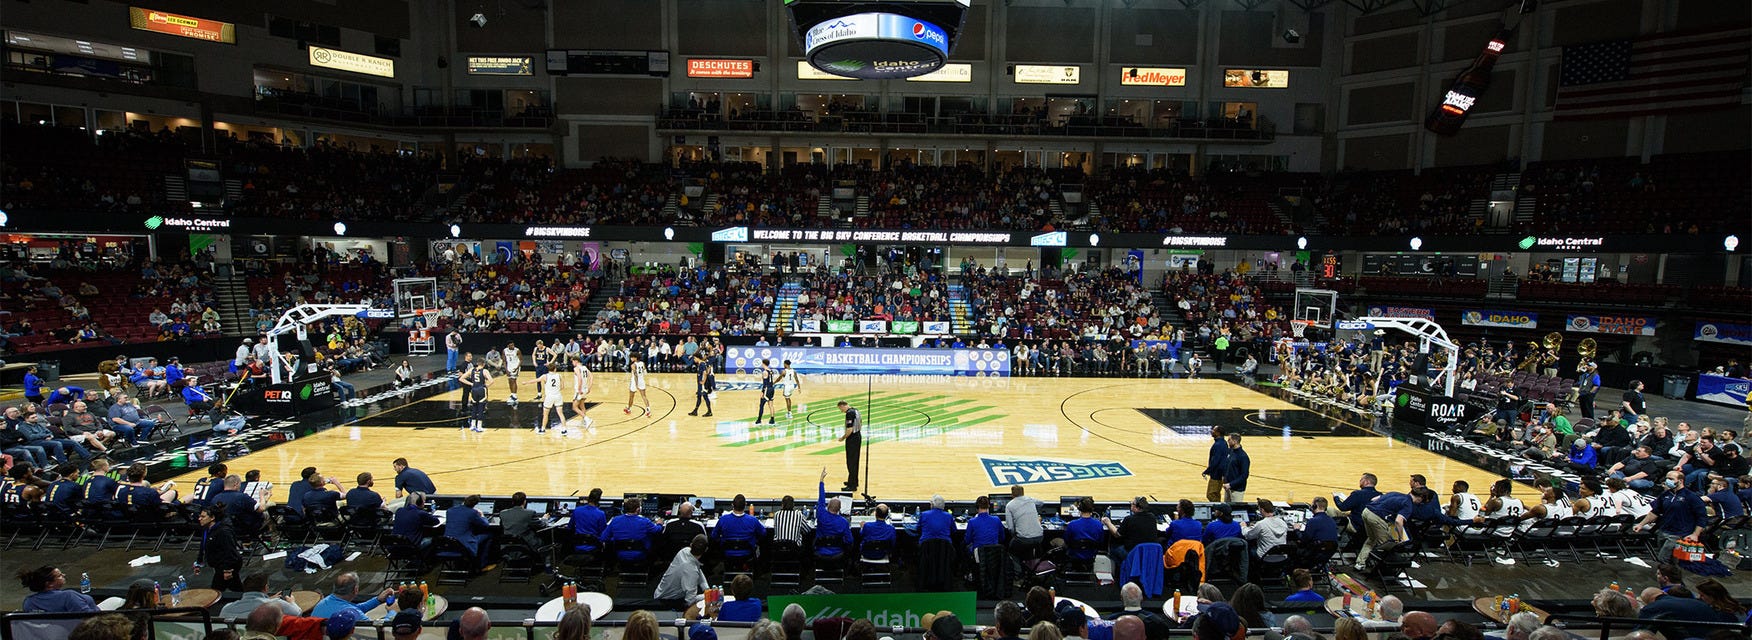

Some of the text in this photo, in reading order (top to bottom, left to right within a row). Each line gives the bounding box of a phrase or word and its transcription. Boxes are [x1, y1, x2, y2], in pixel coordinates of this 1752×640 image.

[185, 31, 215, 40] PROMISE
[812, 26, 824, 36] Blue
[812, 28, 856, 45] Cross of Idaho
[926, 29, 944, 45] pepsi
[333, 53, 359, 62] DOUBLE
[368, 59, 391, 68] RANCH
[692, 61, 749, 70] DESCHUTES
[875, 61, 938, 71] Central
[1445, 90, 1475, 106] SAMUEL
[1443, 97, 1470, 111] ADAMS
[165, 217, 230, 227] Idaho Central
[753, 230, 1011, 242] WELCOME TO THE BIG SKY CONFERENCE BASKETBALL CHAMPIONSHIPS
[1537, 237, 1603, 246] Idaho Central
[1323, 264, 1334, 278] 30
[1387, 307, 1431, 315] EASTERN
[1489, 314, 1530, 324] IDAHO
[1599, 316, 1647, 326] IDAHO
[1339, 322, 1367, 330] GEICO
[1597, 325, 1643, 335] STATE
[783, 351, 804, 363] 2022
[826, 353, 952, 366] BASKETBALL CHAMPIONSHIPS
[474, 374, 480, 383] 5
[788, 373, 792, 381] 1
[551, 378, 557, 387] 2
[313, 384, 331, 393] Central
[1410, 395, 1422, 403] Idaho
[1410, 401, 1426, 409] Central
[1431, 403, 1466, 417] ROAR
[193, 484, 210, 500] 21
[1470, 498, 1478, 511] 5
[1600, 496, 1615, 509] 24
[1506, 505, 1520, 517] 13
